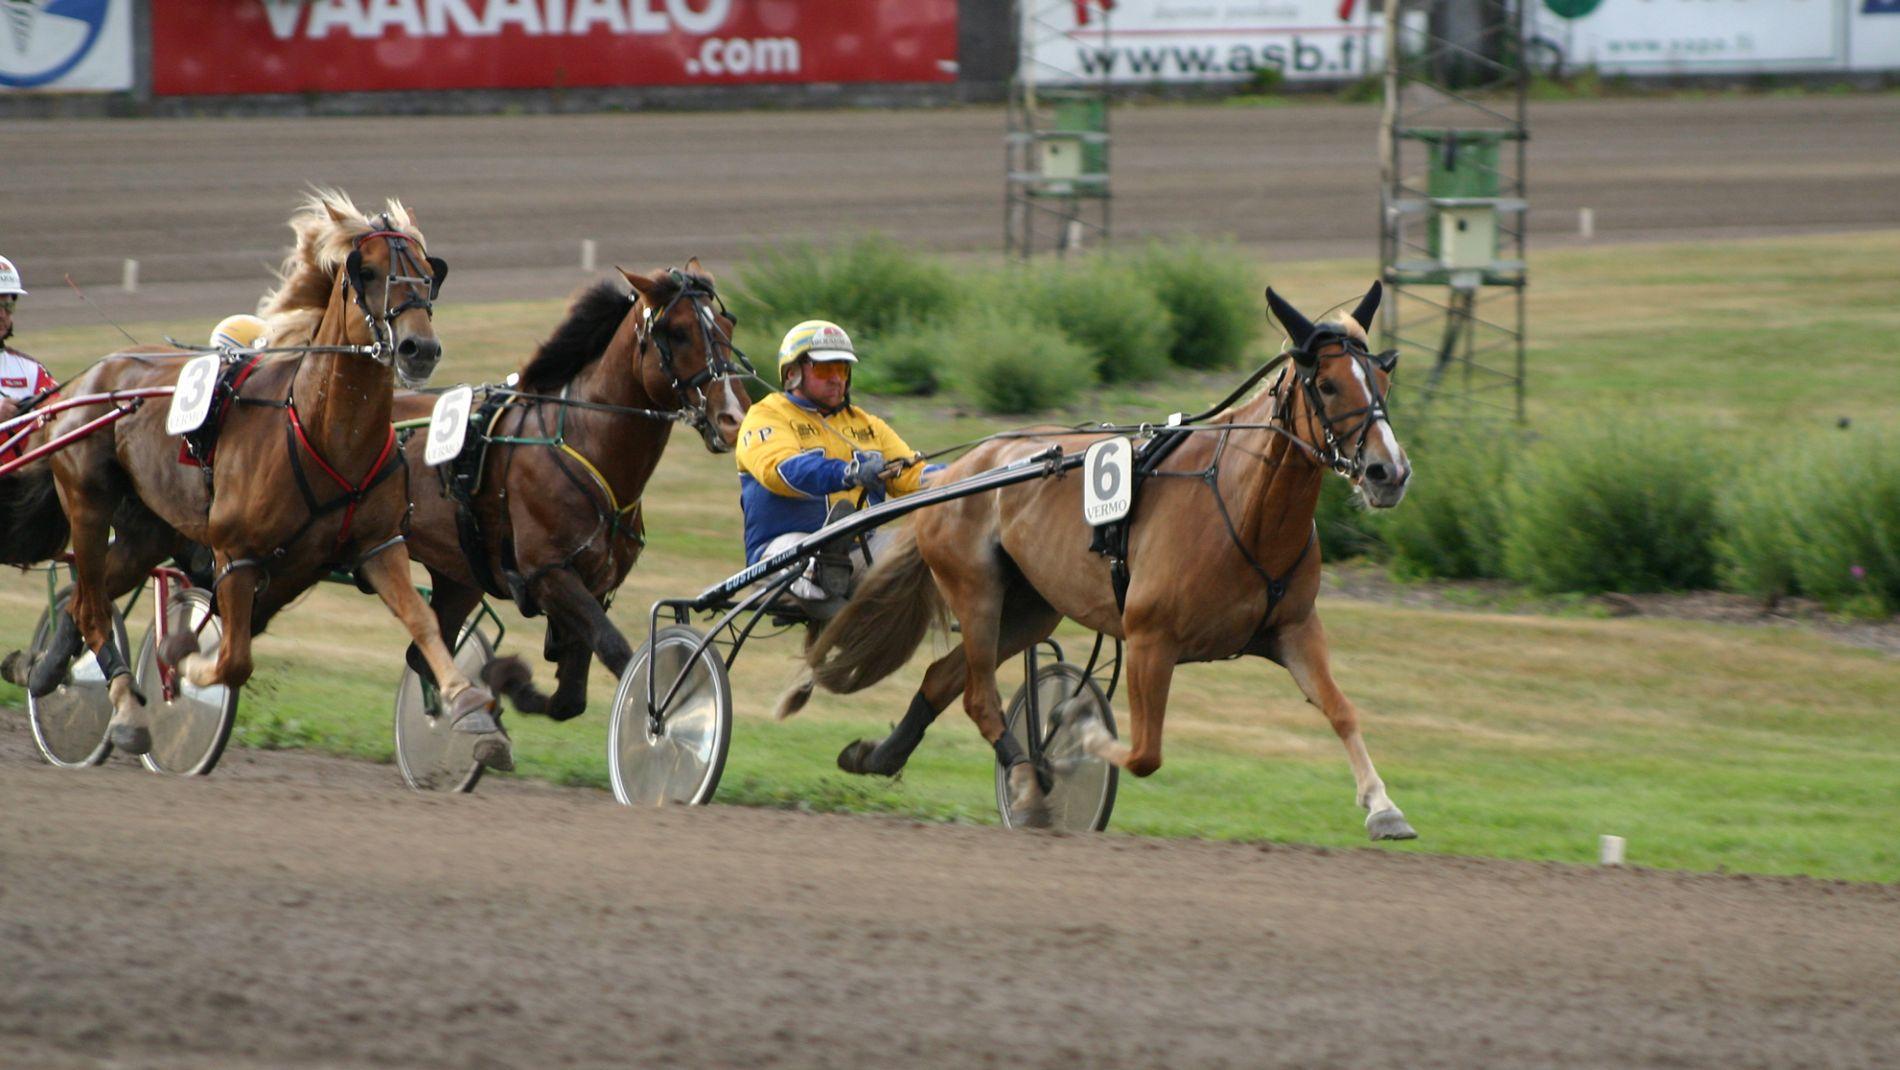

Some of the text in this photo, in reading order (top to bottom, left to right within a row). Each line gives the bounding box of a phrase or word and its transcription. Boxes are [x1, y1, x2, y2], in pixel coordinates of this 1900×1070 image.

[686, 37, 800, 74] .com
[180, 359, 211, 412] 3
[435, 391, 465, 443] 5
[1092, 442, 1121, 501] 6
[1086, 498, 1128, 519] VERMO
[725, 563, 767, 591] CUSTOM
